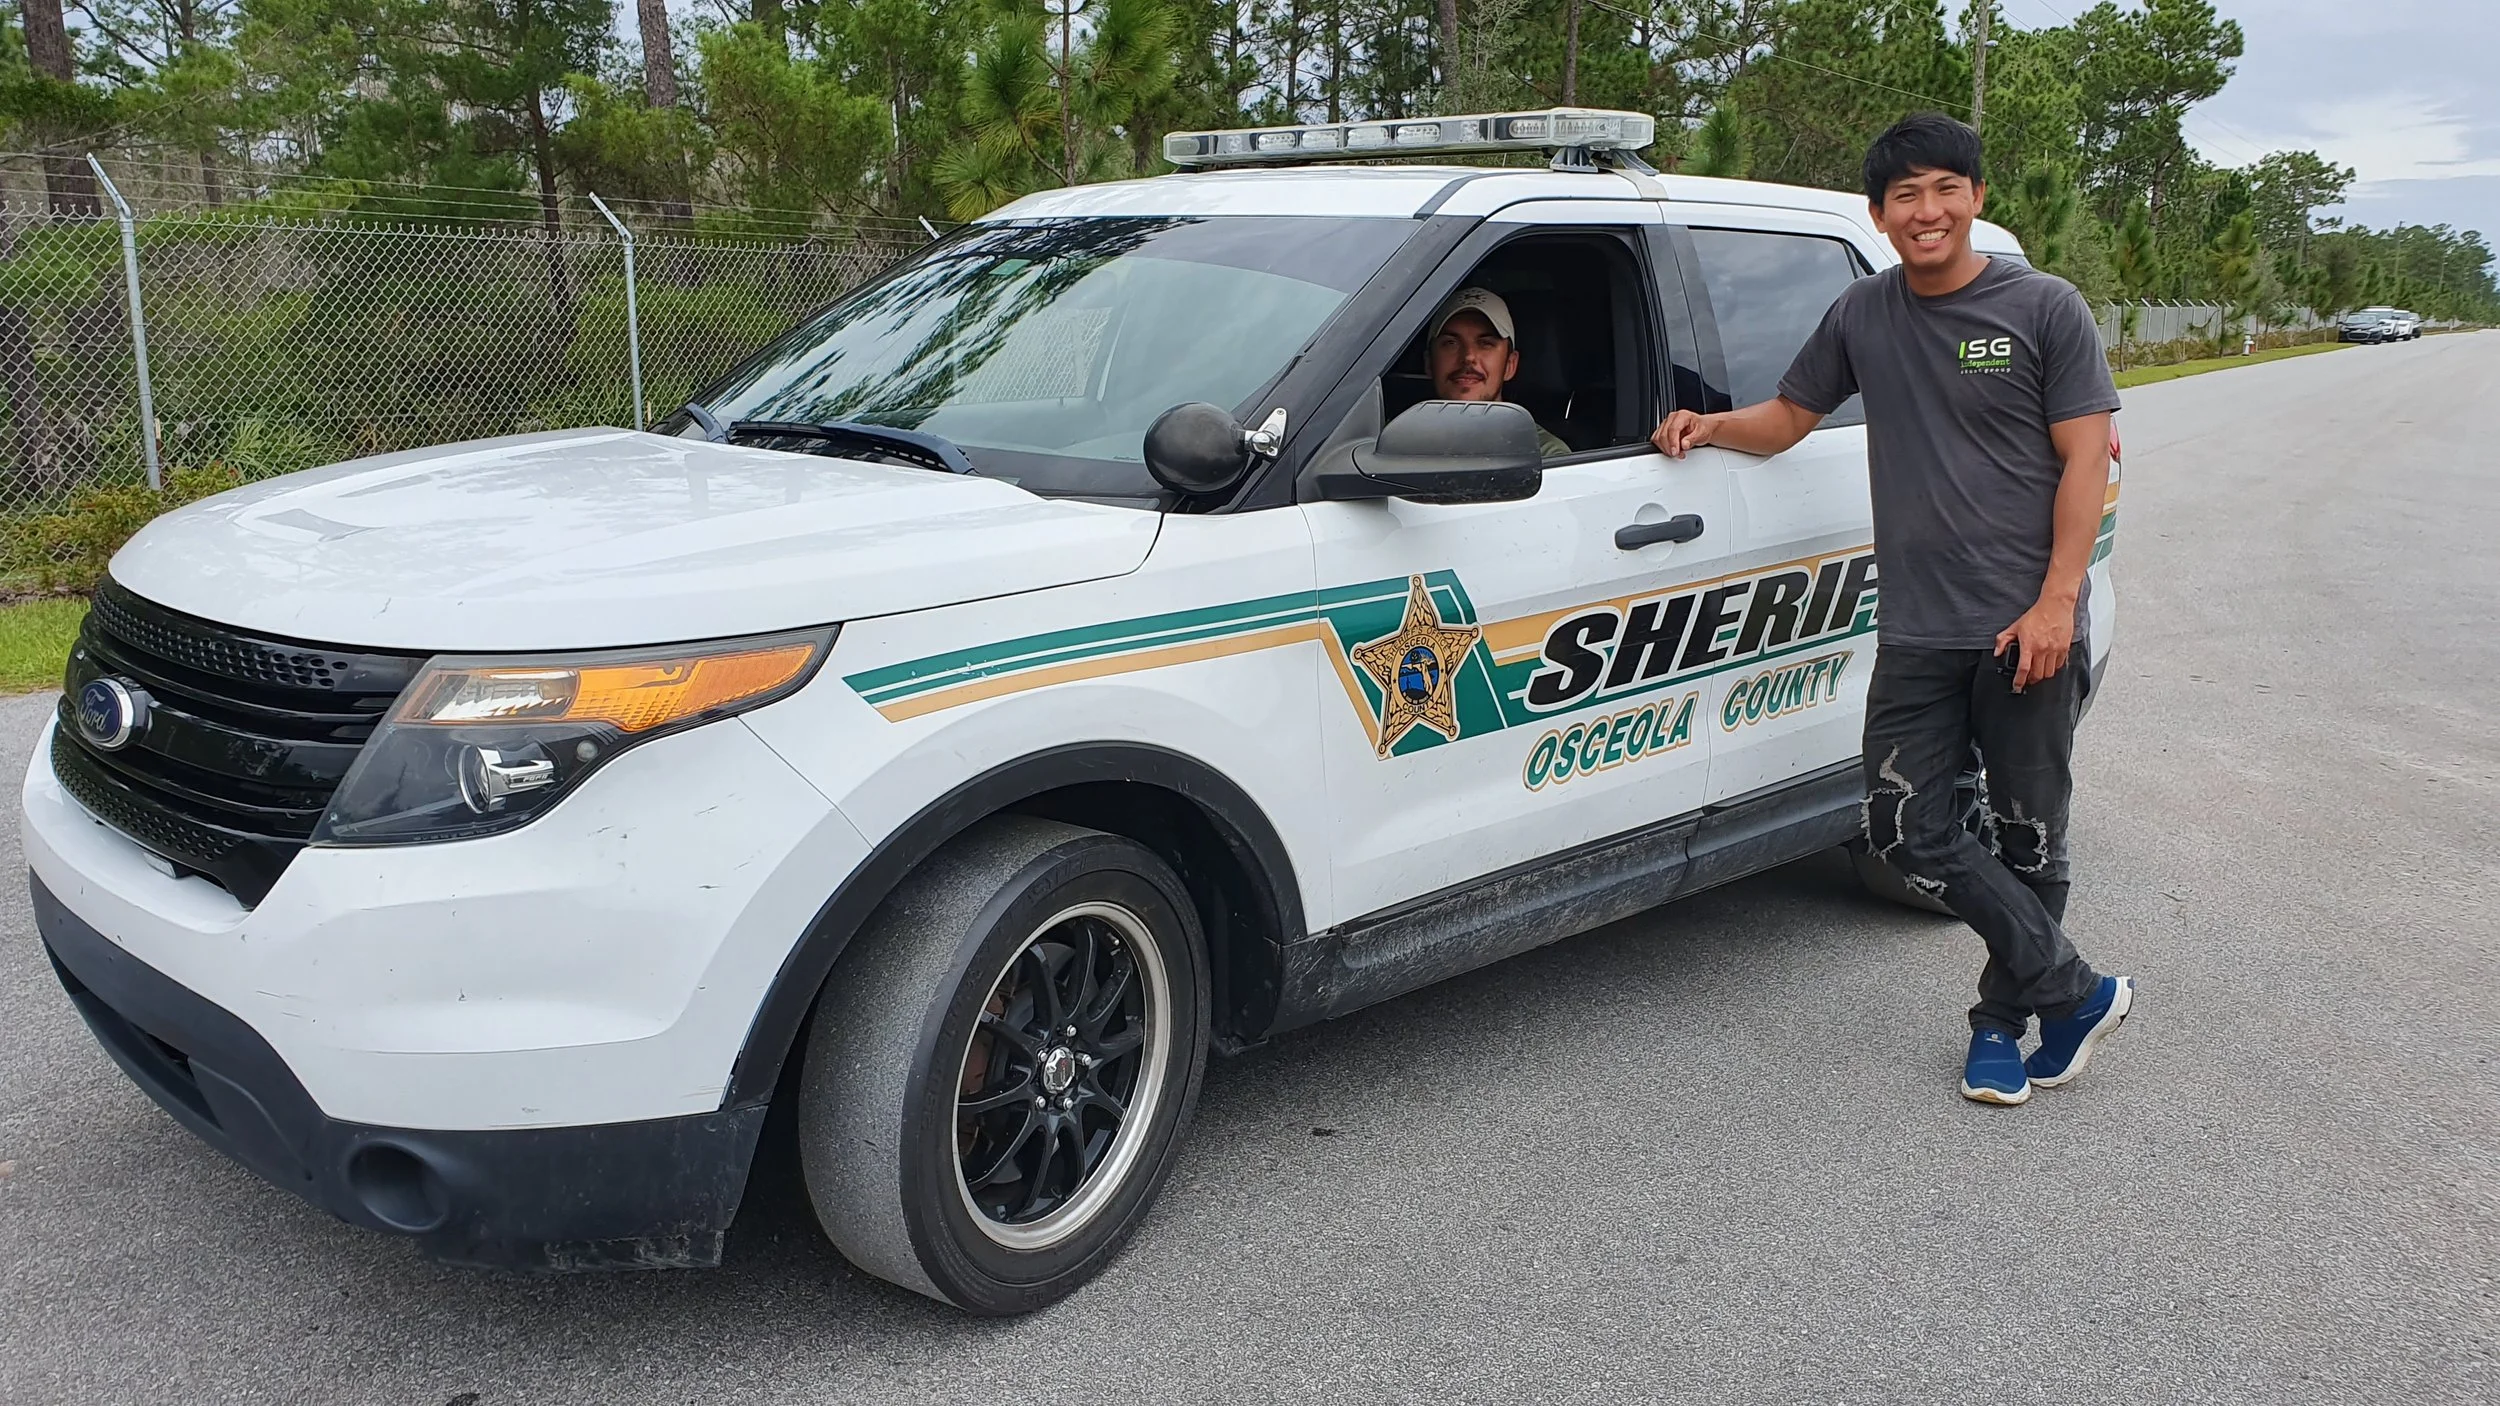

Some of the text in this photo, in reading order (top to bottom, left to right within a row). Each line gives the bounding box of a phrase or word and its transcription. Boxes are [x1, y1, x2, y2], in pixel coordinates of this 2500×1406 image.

[1958, 337, 2011, 359] ISG
[1399, 637, 1436, 657] OSCEOLA
[1527, 553, 1879, 706] SHERIF
[80, 688, 111, 732] Ford
[1525, 652, 1850, 788] OSCEOLA COUNTY
